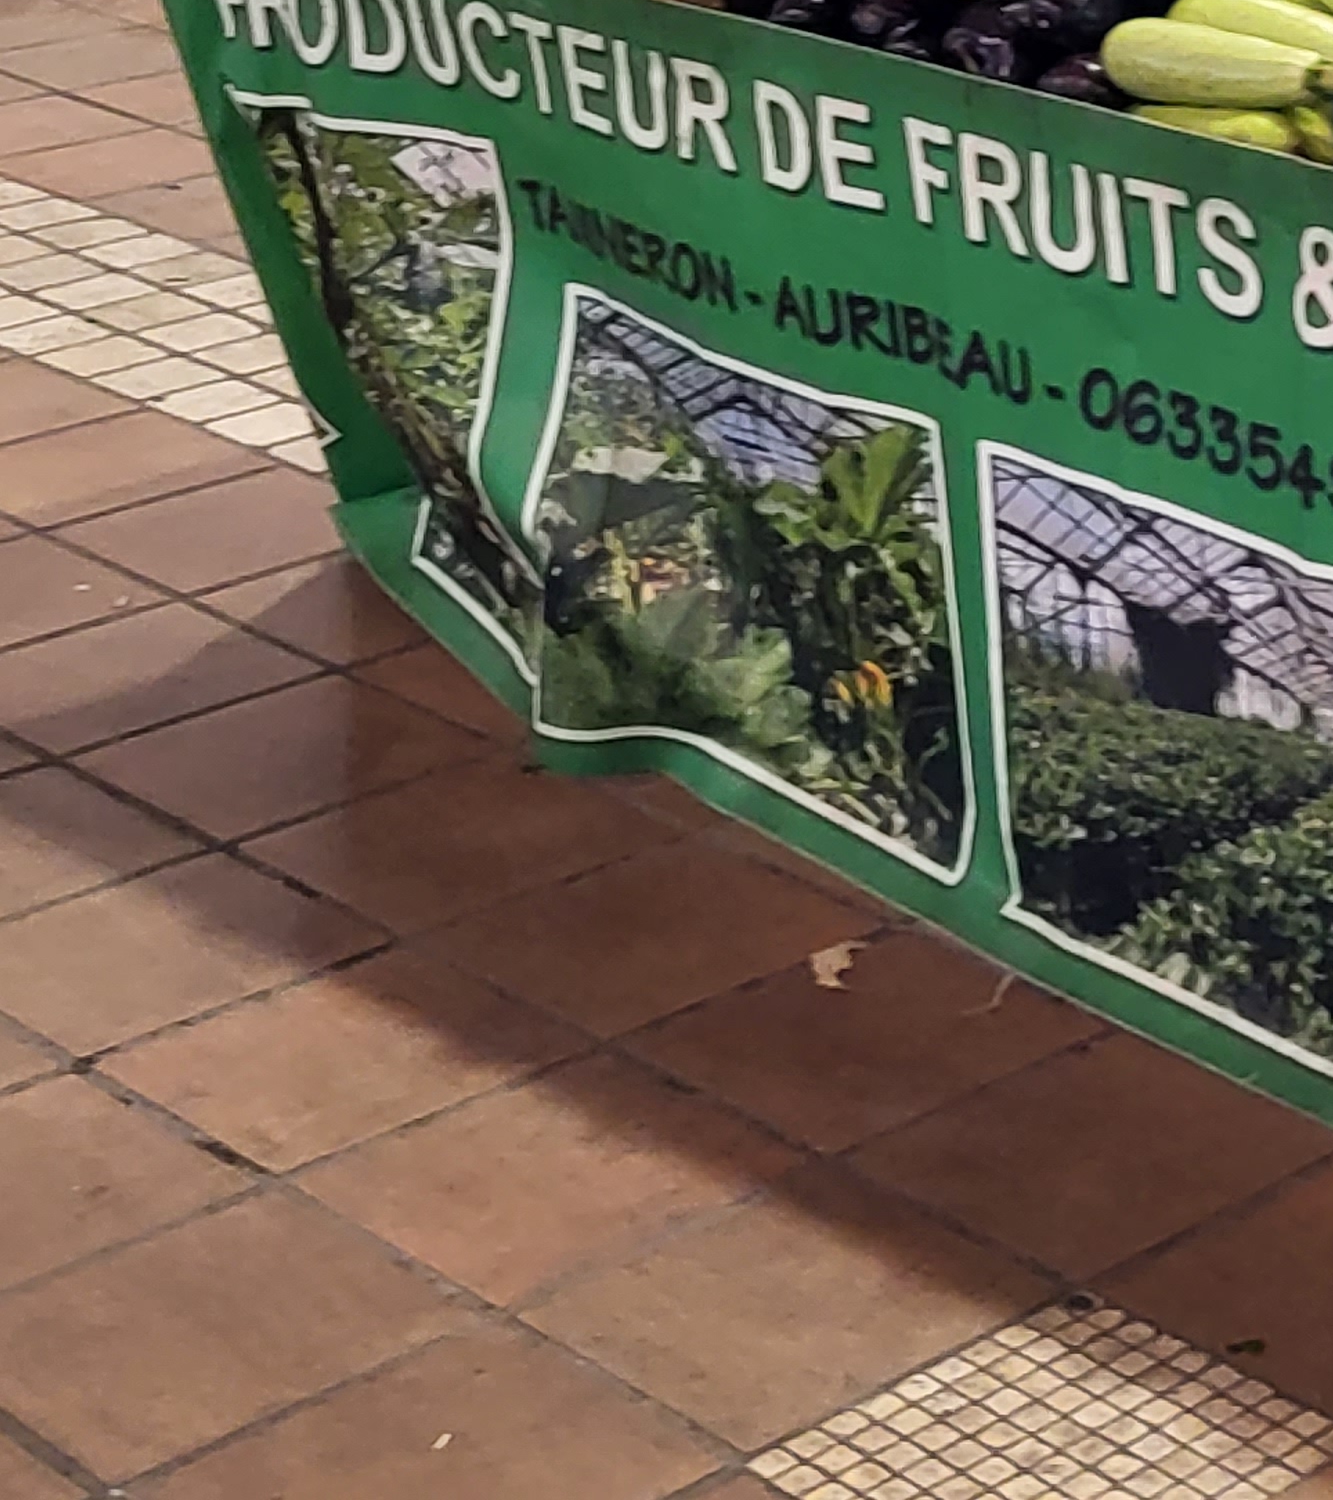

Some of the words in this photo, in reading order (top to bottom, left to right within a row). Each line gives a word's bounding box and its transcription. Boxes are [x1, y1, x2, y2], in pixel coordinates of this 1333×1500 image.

[516, 179, 742, 313] TANNERON
[773, 276, 1033, 403] AURIBEAU
[752, 78, 887, 213] DE
[902, 115, 1263, 319] FRUITS
